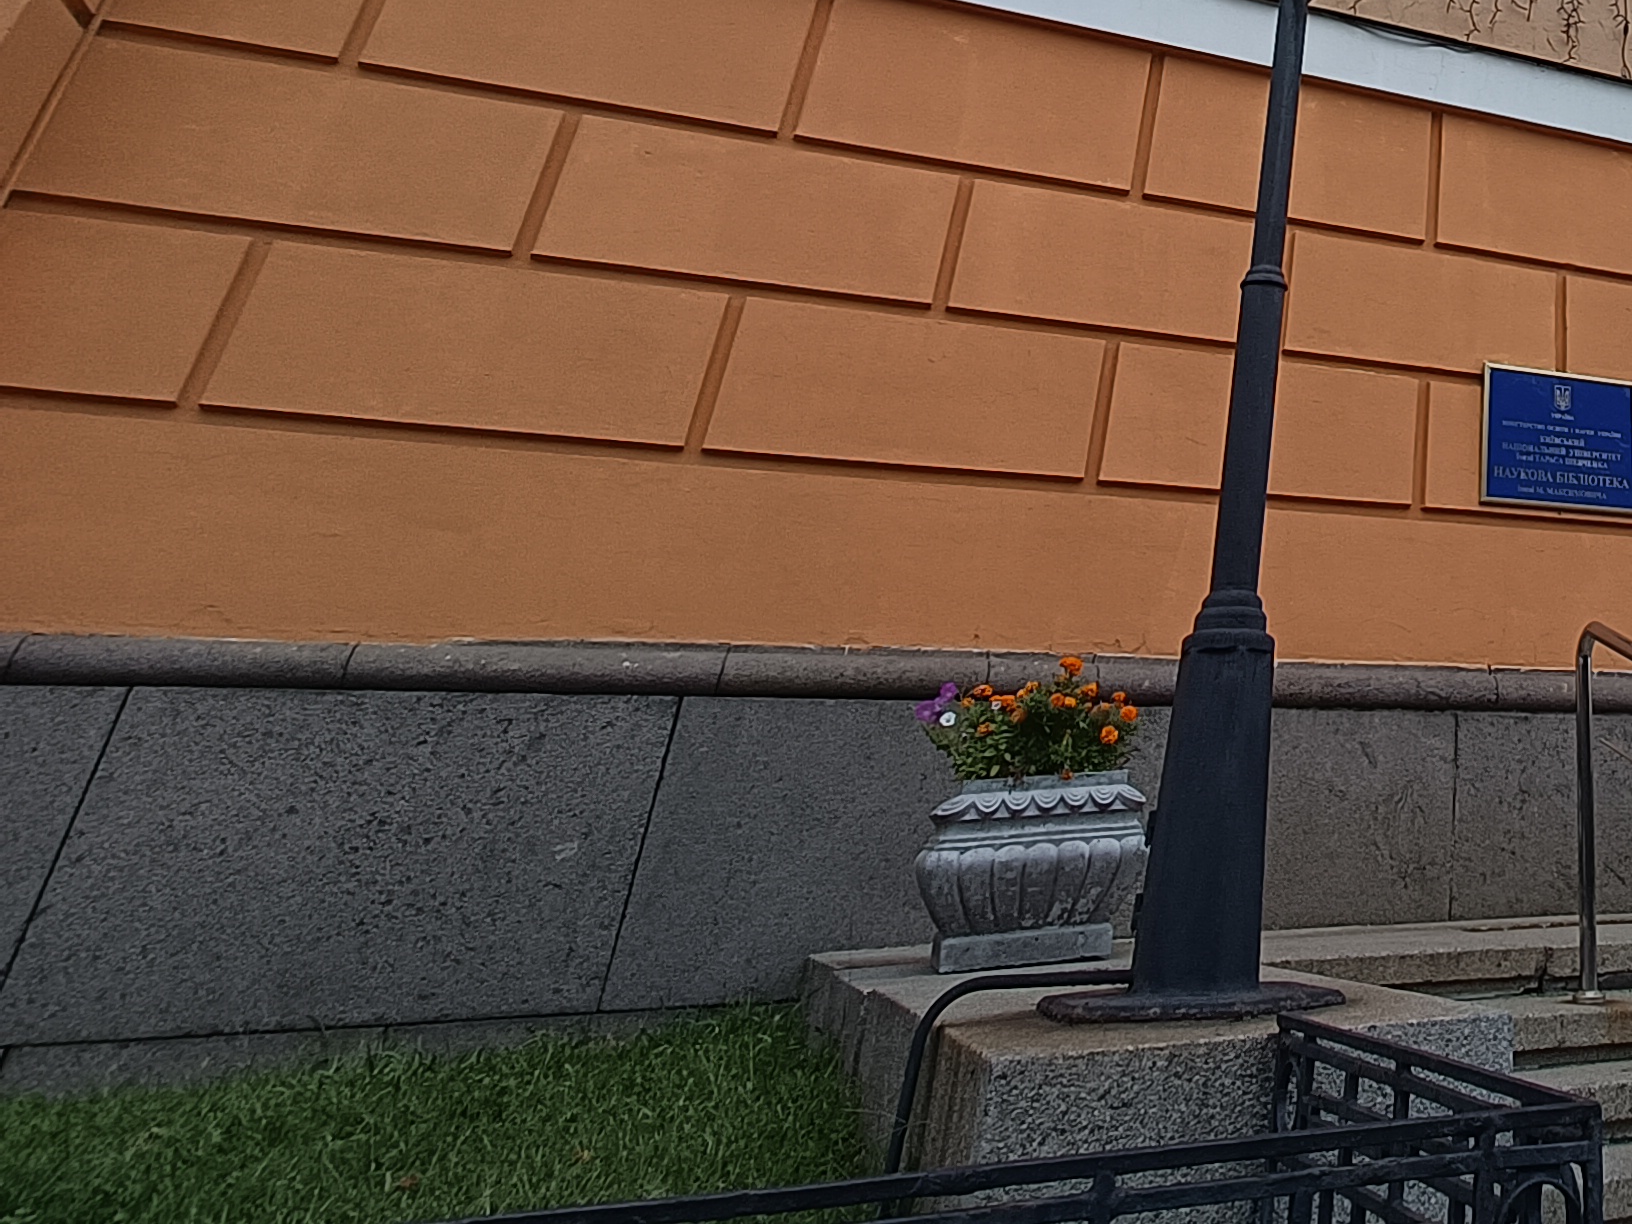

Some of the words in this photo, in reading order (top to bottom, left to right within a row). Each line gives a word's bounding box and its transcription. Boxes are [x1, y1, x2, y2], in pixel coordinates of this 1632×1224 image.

[1535, 454, 1563, 464] ТАРАСА
[1493, 465, 1554, 482] НАУКОВА
[1556, 471, 1630, 489] БІБЛІОТЕКА
